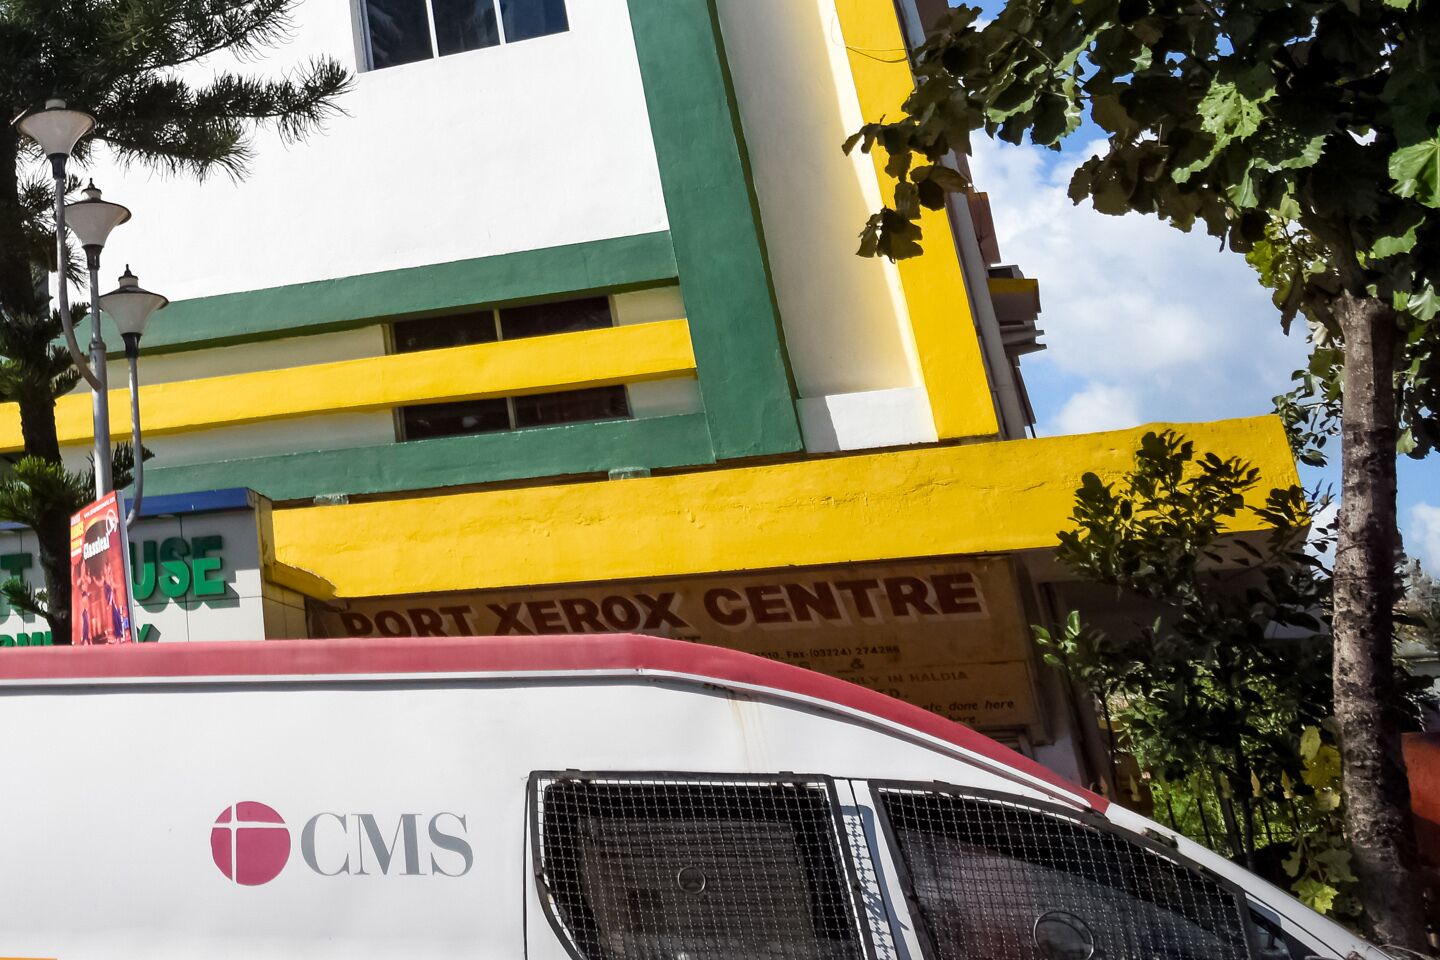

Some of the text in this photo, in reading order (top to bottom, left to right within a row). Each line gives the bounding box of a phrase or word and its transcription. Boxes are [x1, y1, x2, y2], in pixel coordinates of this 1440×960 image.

[129, 535, 226, 602] USE
[338, 572, 986, 638] PORT XEROX CENTRE
[888, 672, 902, 682] IN
[910, 671, 969, 682] HALDIA
[948, 701, 978, 711] done
[984, 699, 1014, 710] here
[300, 812, 474, 877] CMS
